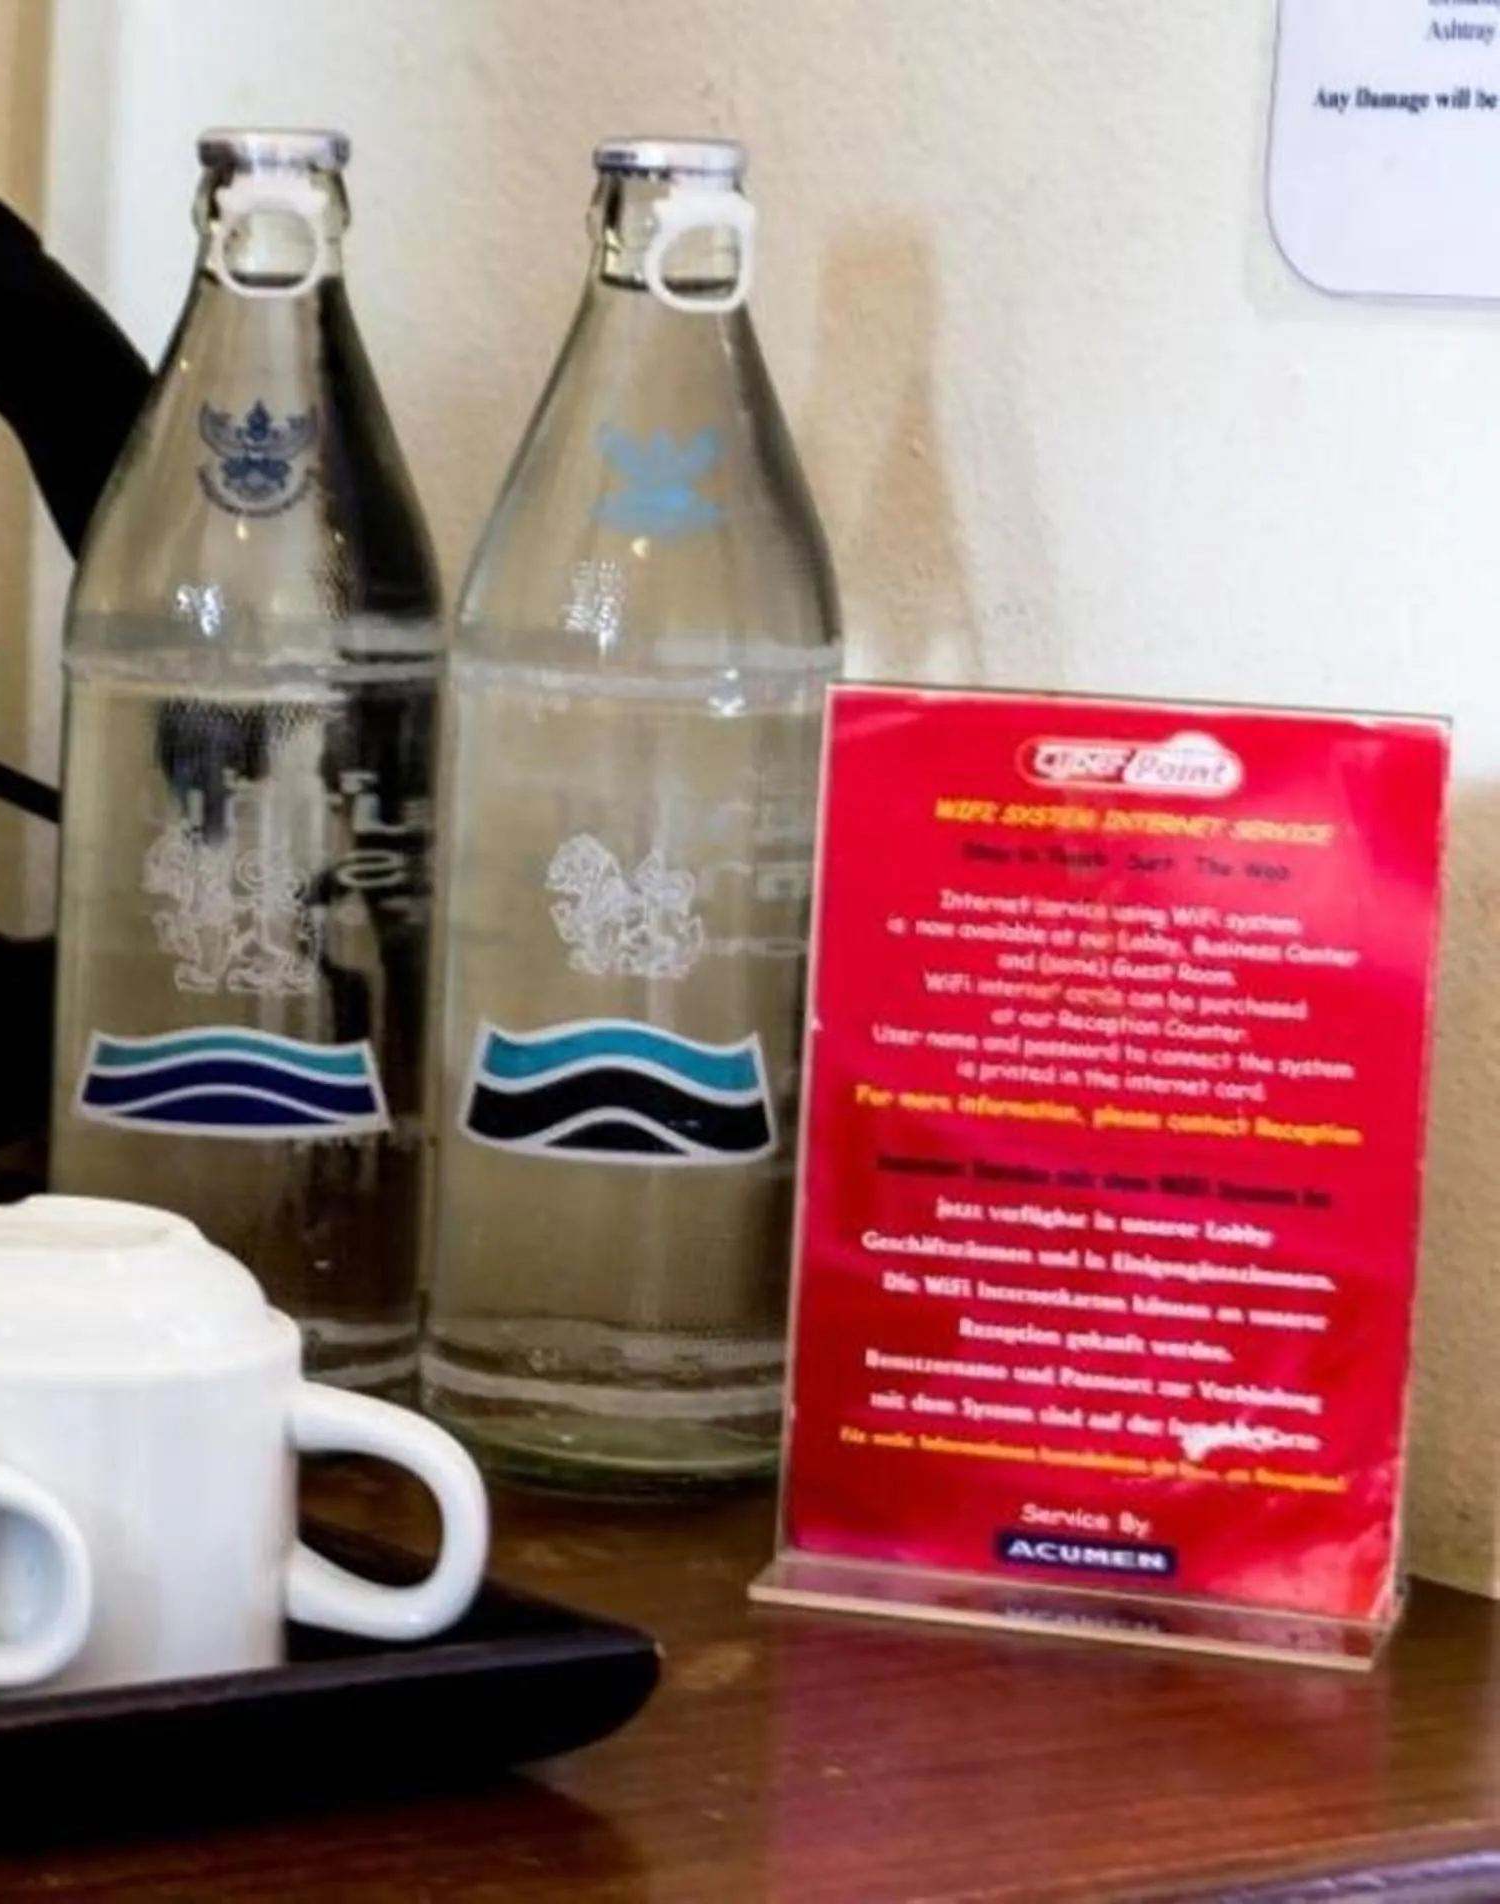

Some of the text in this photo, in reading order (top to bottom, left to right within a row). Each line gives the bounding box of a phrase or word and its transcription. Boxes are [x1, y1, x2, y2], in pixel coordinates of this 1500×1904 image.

[1425, 17, 1496, 46] Ashtray
[1314, 86, 1498, 114] Any Damage will be
[939, 887, 1030, 914] Internet
[1111, 903, 1168, 930] using
[915, 920, 955, 938] now
[957, 921, 1047, 945] available
[1191, 933, 1283, 963] Business
[1285, 941, 1360, 969] Center
[997, 951, 1035, 972] and
[1112, 956, 1174, 982] Guest
[1167, 989, 1195, 1012] be
[1199, 994, 1309, 1021] purchased
[990, 1007, 1016, 1027] at
[1018, 1011, 1055, 1029] our
[1057, 1008, 1161, 1039] Reception
[871, 1022, 1356, 1080] User name and password to connect the system
[978, 1062, 1056, 1085] printed
[1059, 1066, 1082, 1085] in
[1083, 1068, 1120, 1090] the
[1123, 1072, 1212, 1097] internet
[855, 1083, 893, 1107] For
[899, 1091, 952, 1112] more
[1092, 1103, 1162, 1132] please
[1166, 1112, 1249, 1137] contact
[1254, 1115, 1364, 1146] Reception
[1038, 1248, 1081, 1270] und
[882, 1269, 920, 1295] Die
[1012, 1364, 1056, 1386] und
[869, 1389, 906, 1411] mit
[910, 1391, 957, 1416] dem
[1020, 1501, 1154, 1539] Service By
[1007, 1539, 1169, 1573] ACUMEN
